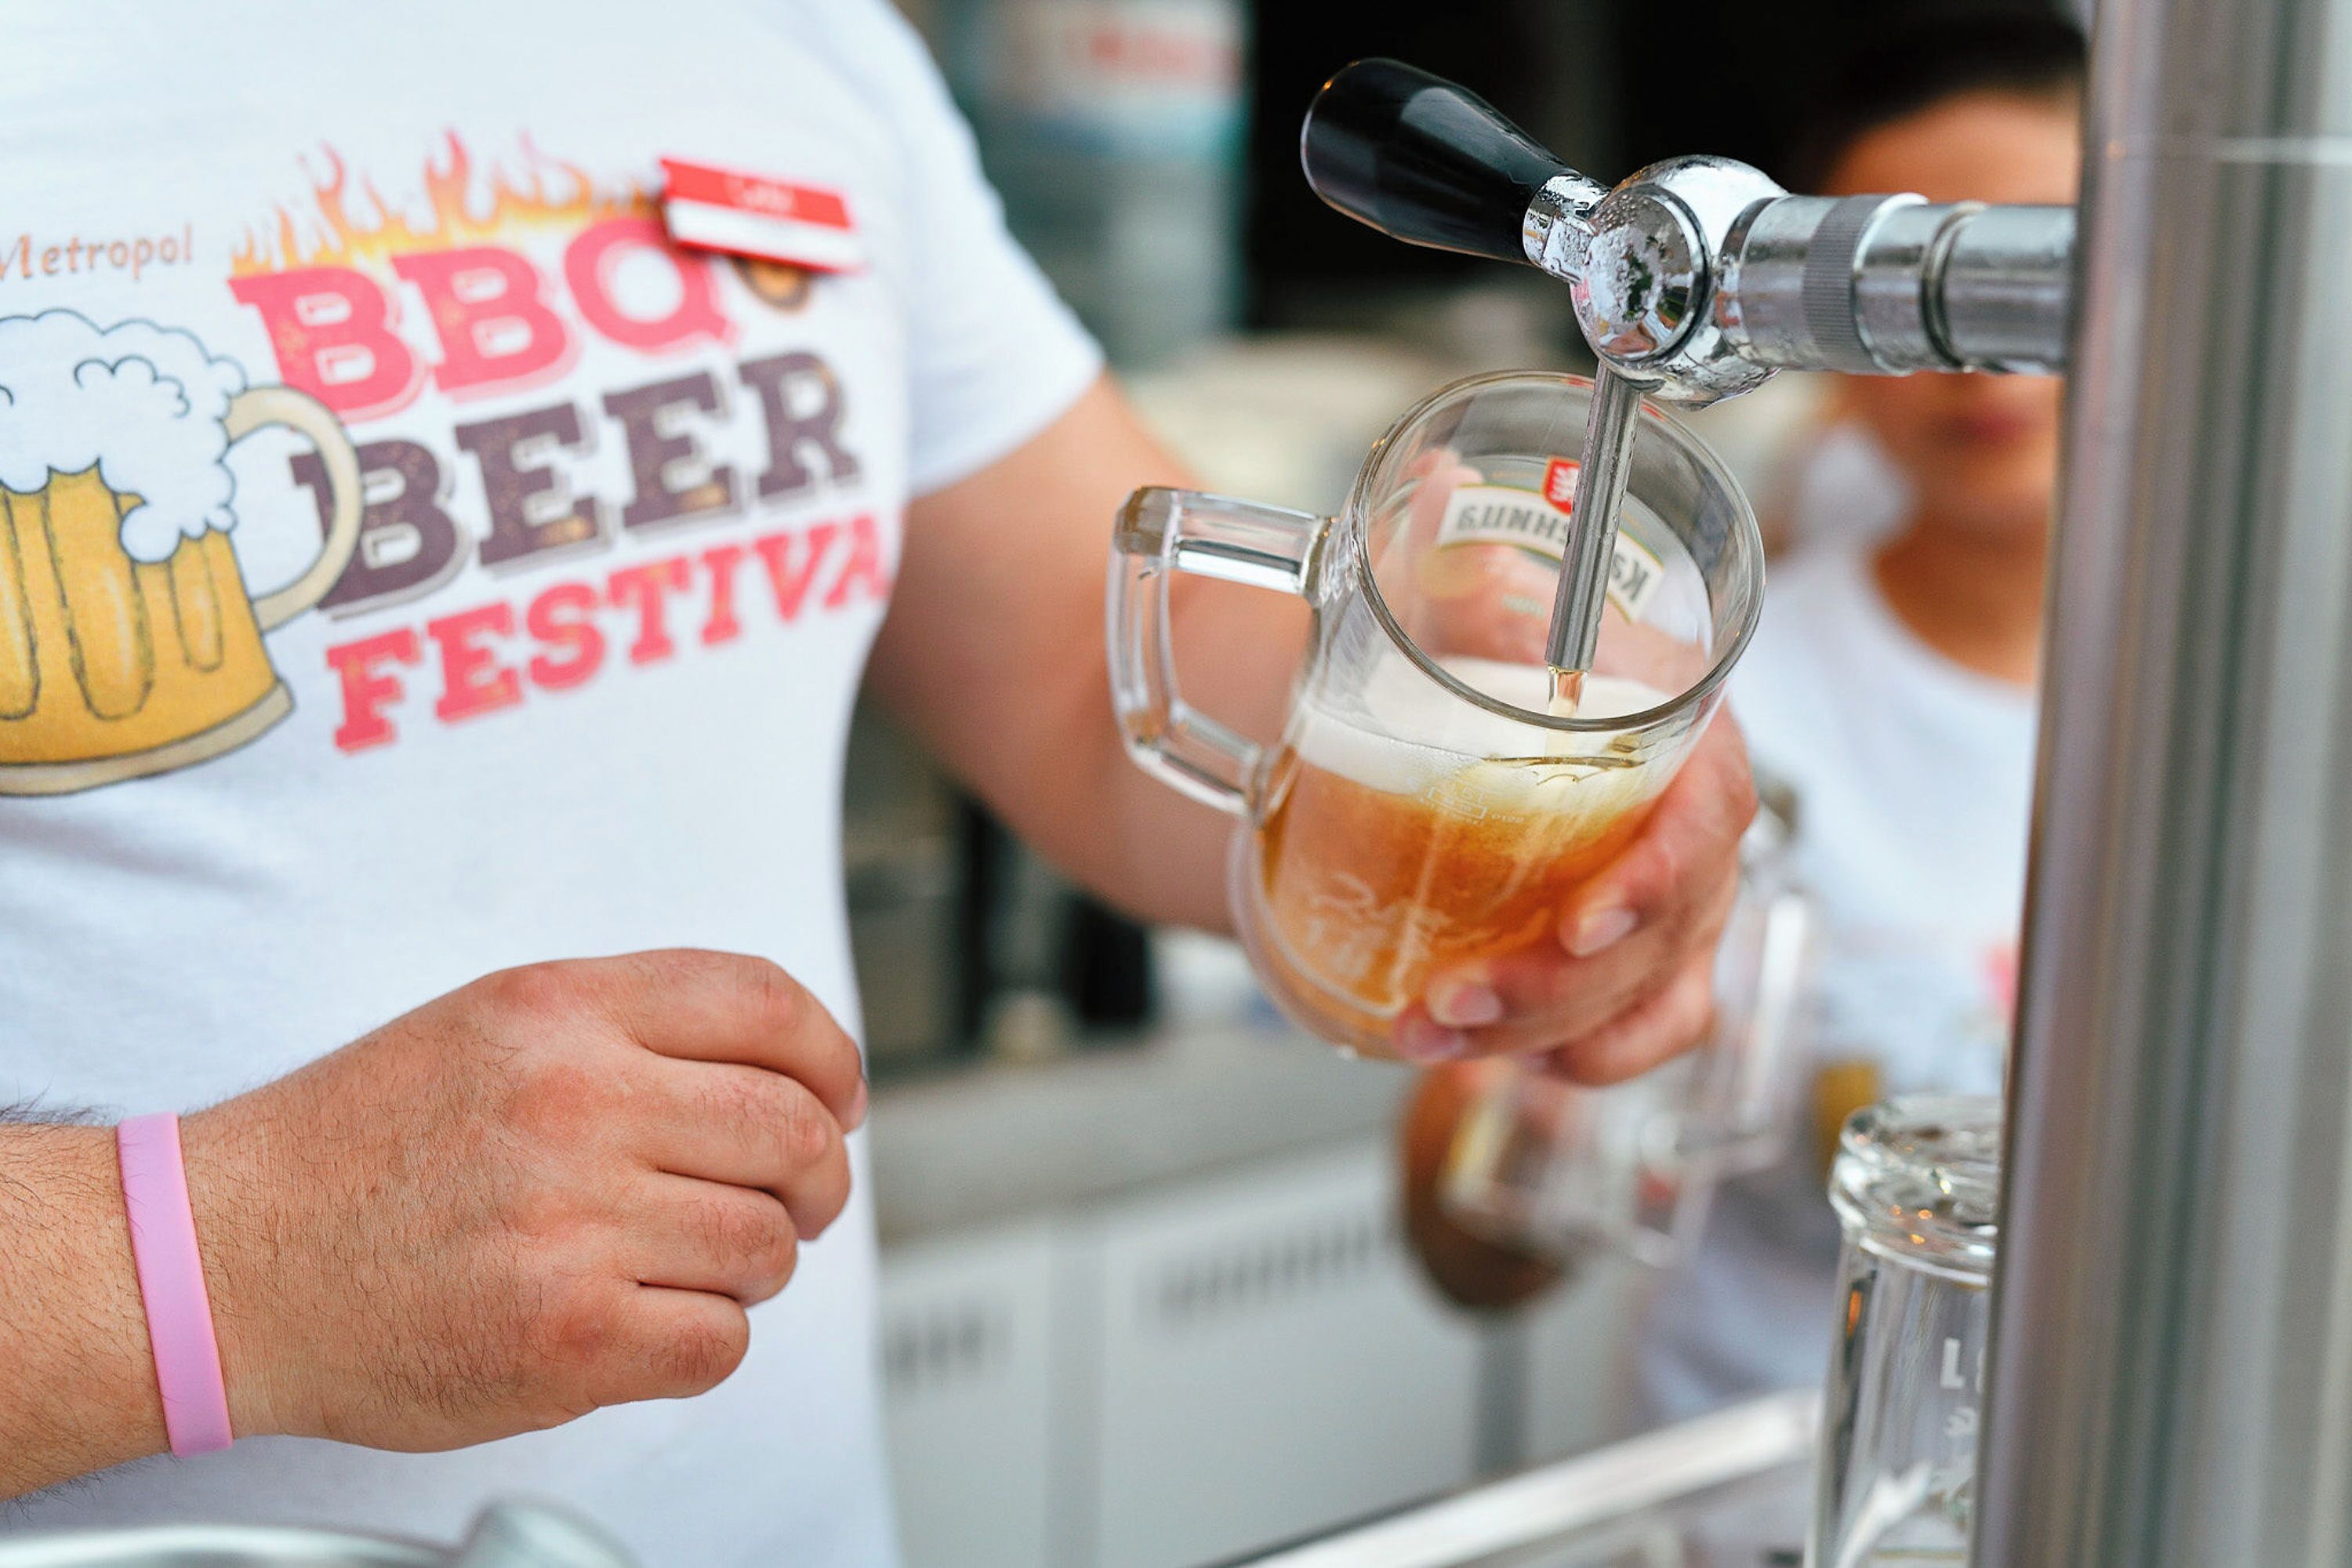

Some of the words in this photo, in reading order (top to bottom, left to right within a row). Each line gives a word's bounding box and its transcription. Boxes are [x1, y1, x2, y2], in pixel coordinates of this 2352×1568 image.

[227, 216, 740, 425] BBQ
[289, 350, 867, 619] BEER
[325, 514, 894, 754] FESTIVA
